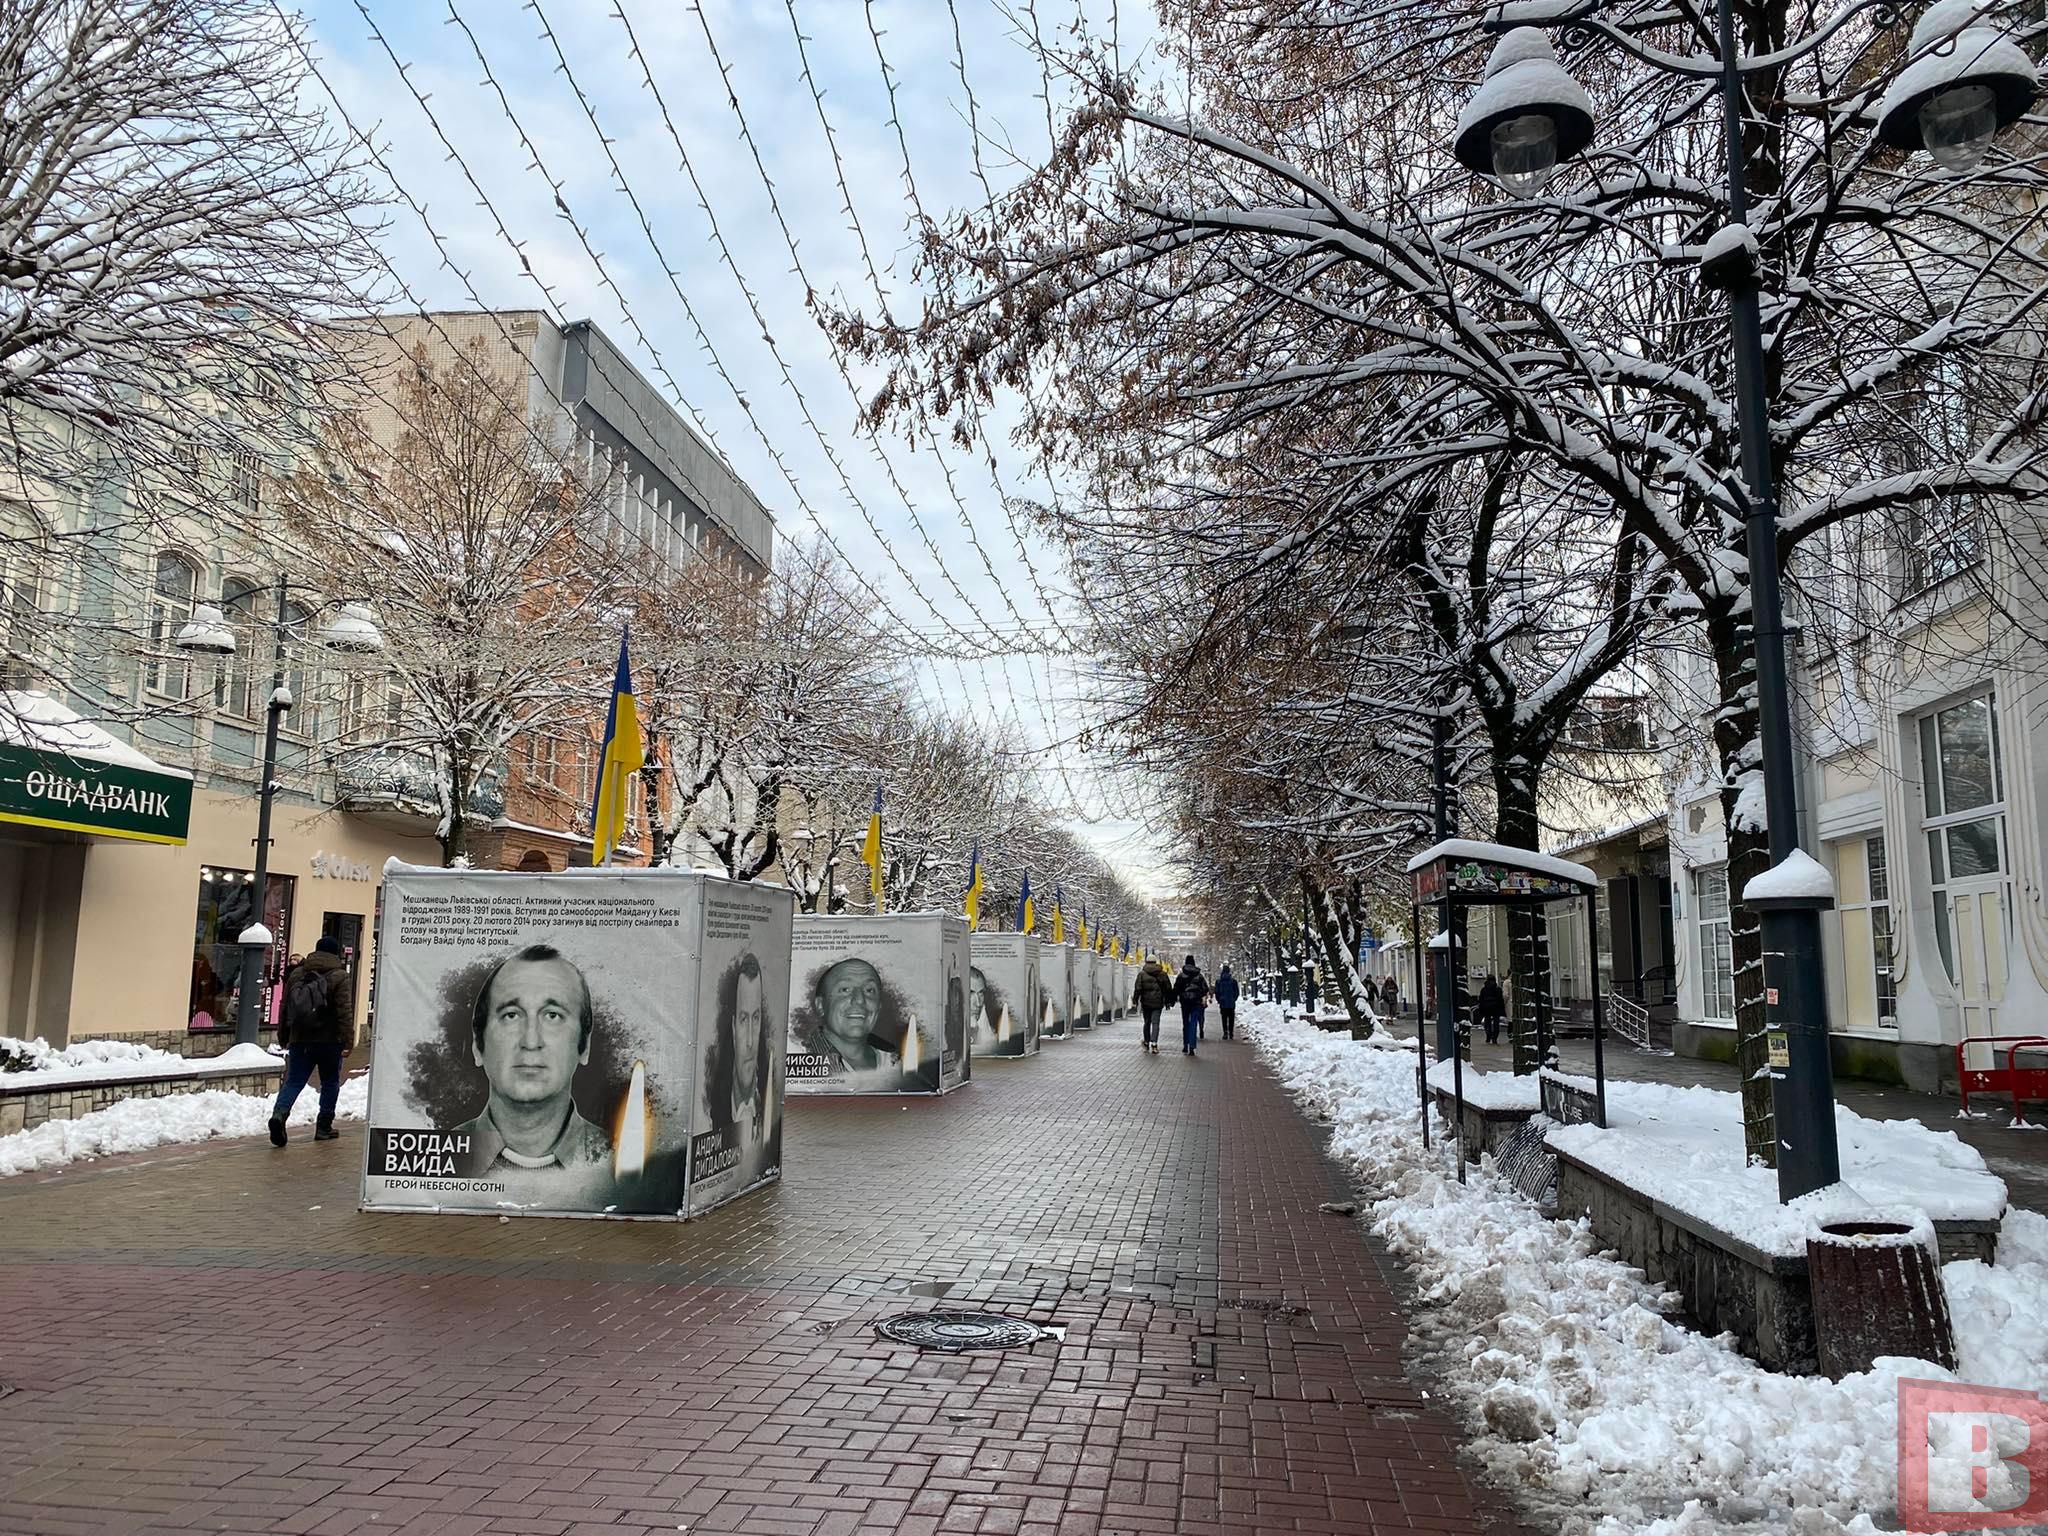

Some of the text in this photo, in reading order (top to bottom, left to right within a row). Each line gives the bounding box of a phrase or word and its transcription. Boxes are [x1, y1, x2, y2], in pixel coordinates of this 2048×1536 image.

[25, 770, 170, 818] ОЩАДБАНК
[403, 895, 655, 907] Мешканець Львівської області. Активний учасник національного
[402, 905, 681, 918] відродження 1989-1991 років. Вступив до самооборони Майдану у Києві
[408, 916, 431, 925] грудні
[433, 915, 451, 924] 2013
[451, 917, 471, 926] року.
[473, 916, 483, 925] 20
[513, 916, 531, 925] 2014
[532, 918, 551, 927] року
[552, 919, 584, 928] загинув
[585, 918, 597, 927] від
[598, 918, 633, 928] пострілу
[634, 918, 673, 928] снайпера
[400, 927, 427, 936] голову
[440, 927, 465, 936] вулиці
[466, 927, 519, 937] Інститутській.
[400, 936, 431, 946] Богдану
[433, 936, 455, 945] Вайді
[457, 936, 475, 946] було
[476, 936, 487, 945] 48
[263, 987, 272, 1023] KISSED
[387, 1133, 470, 1155] БОГДАН
[385, 1152, 456, 1177] ВАЙДА
[419, 1179, 470, 1191] НЕБЕСНОЇ
[472, 1182, 505, 1193] СОТНІ
